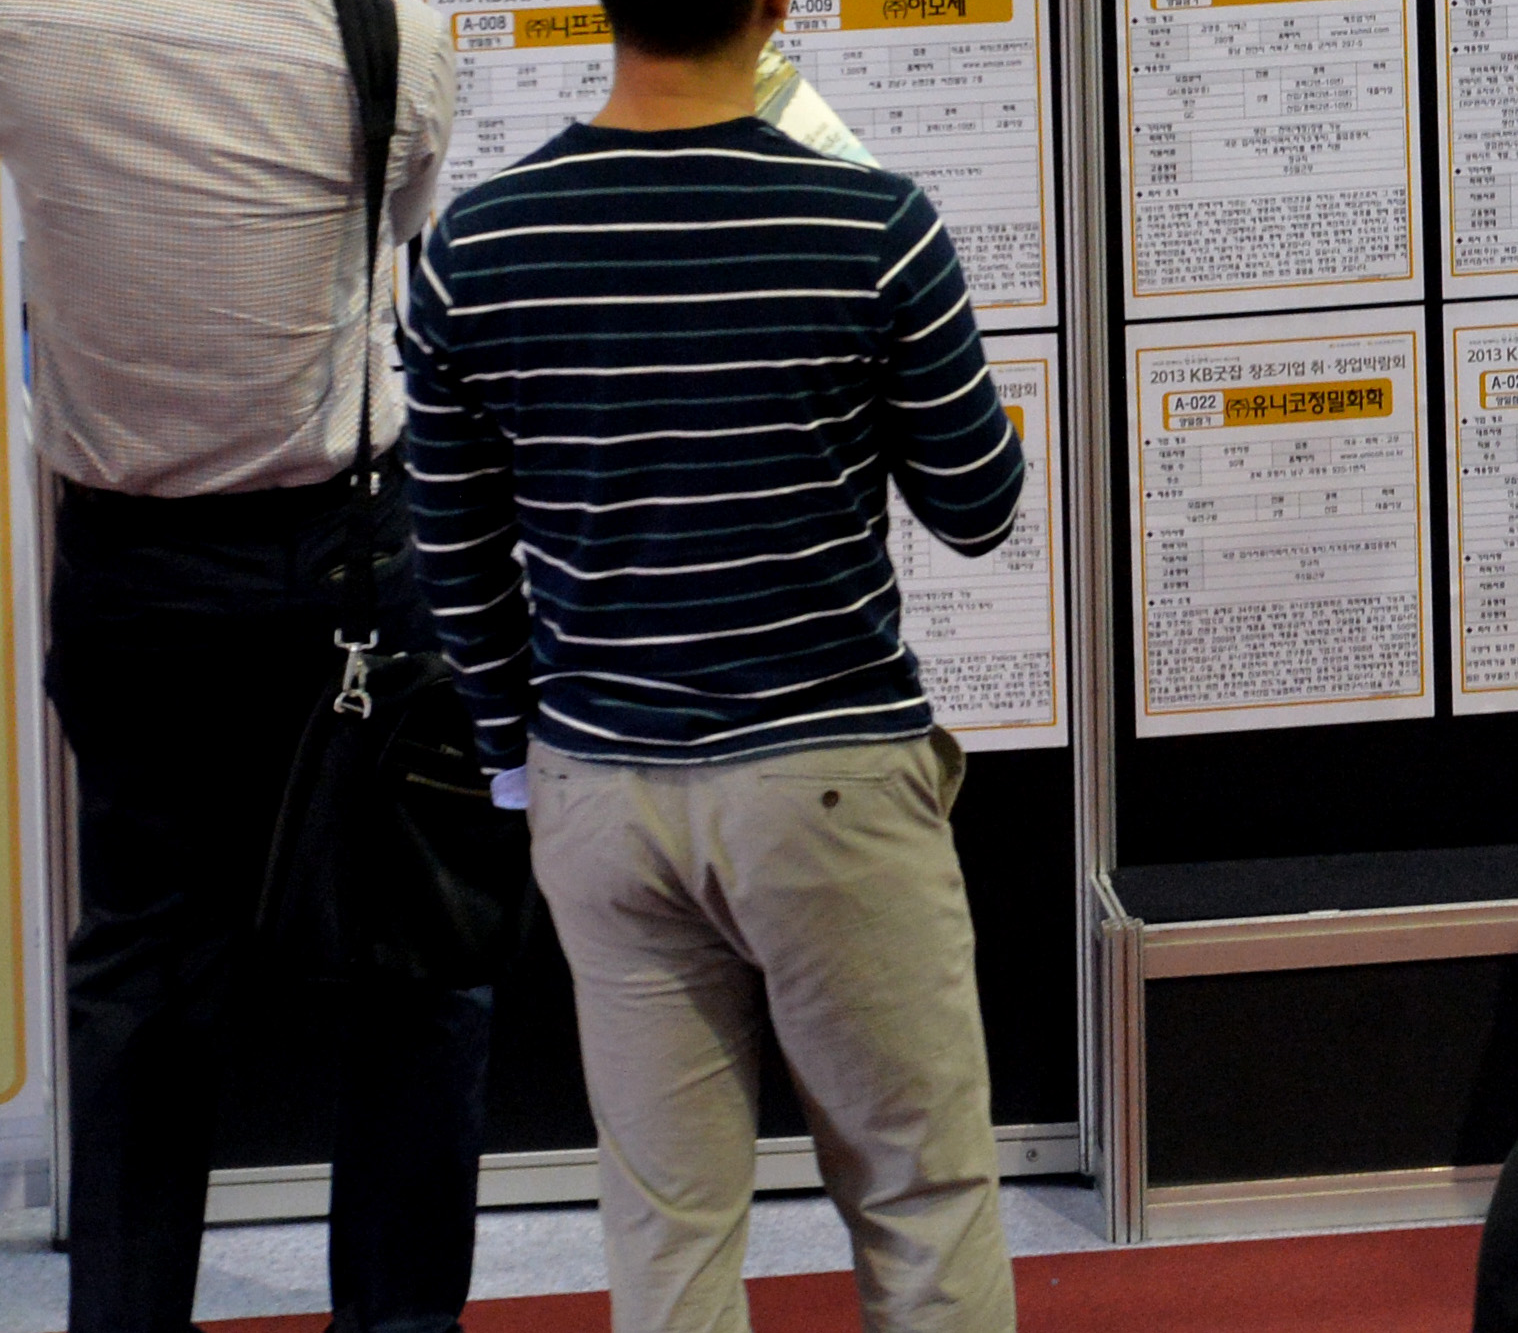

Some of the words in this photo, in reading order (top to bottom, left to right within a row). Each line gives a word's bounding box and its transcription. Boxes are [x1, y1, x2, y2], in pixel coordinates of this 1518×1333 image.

[463, 15, 507, 31] A-008
[1467, 347, 1502, 363] 2013
[1150, 368, 1186, 384] 2013
[1248, 360, 1306, 381] 창조기업
[1175, 395, 1216, 411] A-022
